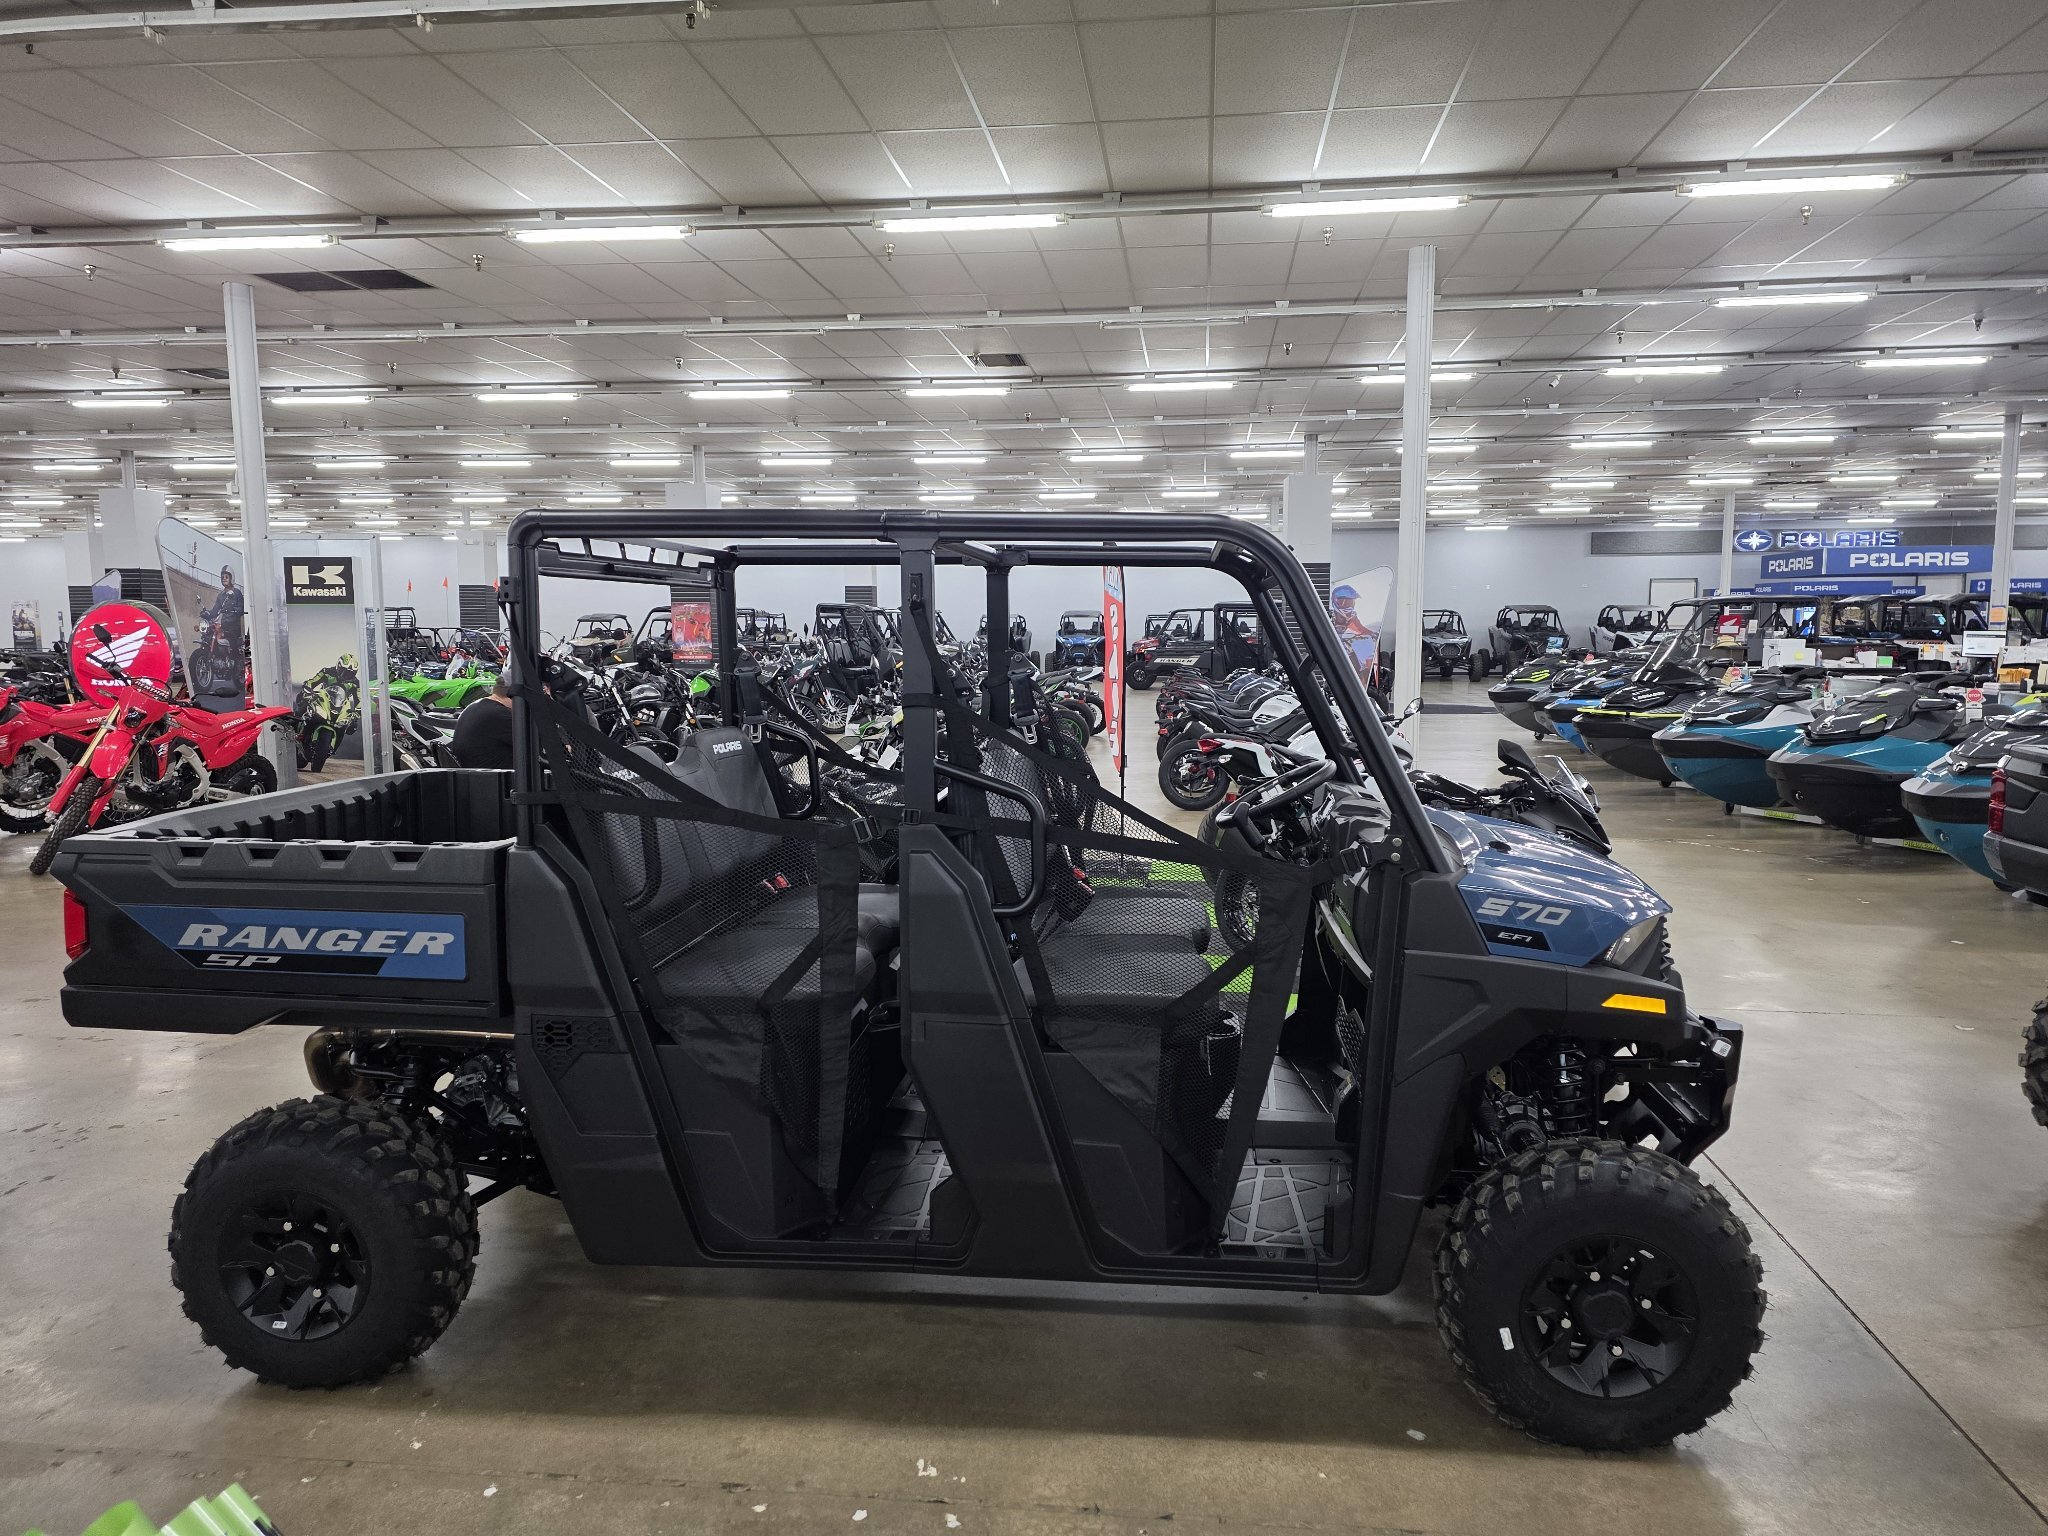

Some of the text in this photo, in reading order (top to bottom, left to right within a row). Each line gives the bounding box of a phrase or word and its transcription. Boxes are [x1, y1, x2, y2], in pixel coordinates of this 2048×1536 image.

[1778, 530, 1900, 549] POLARIS
[1768, 556, 1814, 573] POLARIS
[1849, 551, 1970, 568] POLARIS
[292, 586, 347, 597] Kawasaki
[1794, 584, 1839, 592] POLARIS
[221, 717, 246, 730] HONDA
[712, 740, 743, 755] POLARIS
[1475, 897, 1572, 926] 570
[177, 923, 455, 955] RANGER
[1497, 931, 1533, 942] EFI
[202, 953, 282, 968] SP
